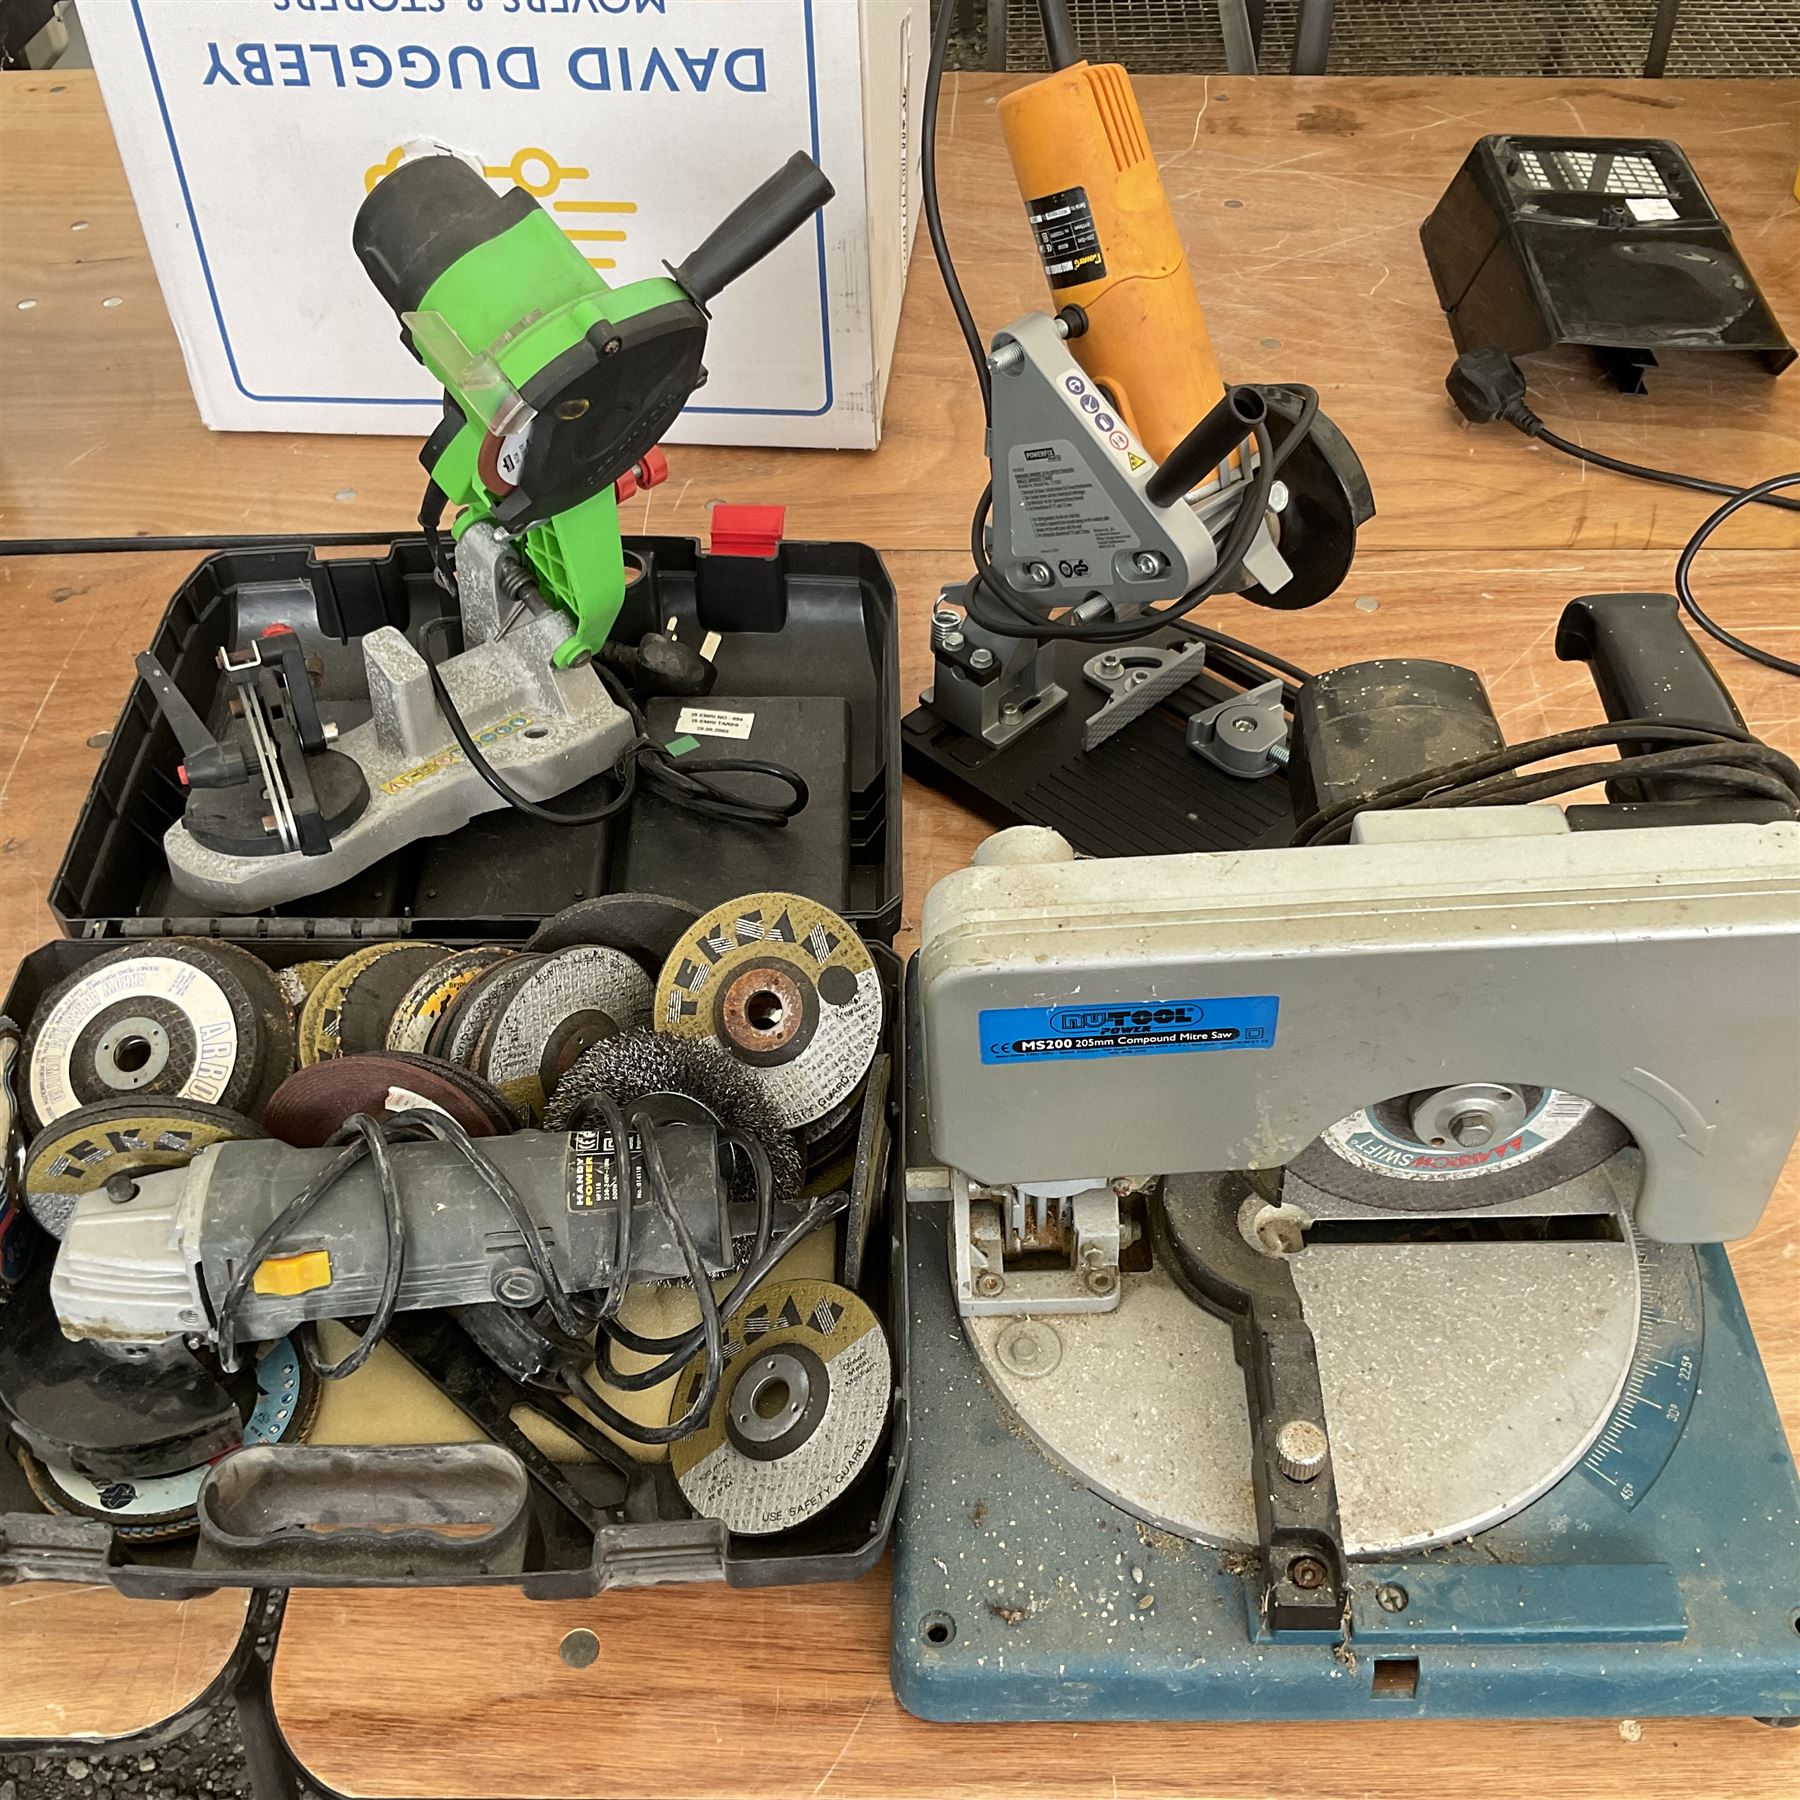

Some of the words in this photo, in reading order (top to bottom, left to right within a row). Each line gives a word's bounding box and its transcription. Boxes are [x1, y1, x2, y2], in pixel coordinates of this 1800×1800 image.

[202, 41, 541, 91] DUGGLEBY
[568, 46, 768, 93] DAVID
[666, 908, 841, 1024] TEKSAN
[1021, 1039, 1072, 1052] MS200
[1075, 1037, 1114, 1048] 205mm
[1117, 1034, 1175, 1046] Compound
[1179, 1031, 1208, 1041] Mitre
[1211, 1030, 1233, 1040] Saw
[1101, 1025, 1152, 1035] POWER
[184, 1021, 232, 1105] ARRO
[818, 1075, 850, 1108] GUARD
[45, 1128, 194, 1178] TEKS
[1360, 1139, 1414, 1167] SWIFT
[576, 1157, 584, 1206] HANDY
[585, 1156, 593, 1206] POWER
[1666, 1404, 1680, 1422] 30°
[762, 1511, 783, 1522] USE
[789, 1486, 831, 1517] SAFETY
[835, 1441, 867, 1484] GUARD
[1620, 1483, 1634, 1501] 45°
